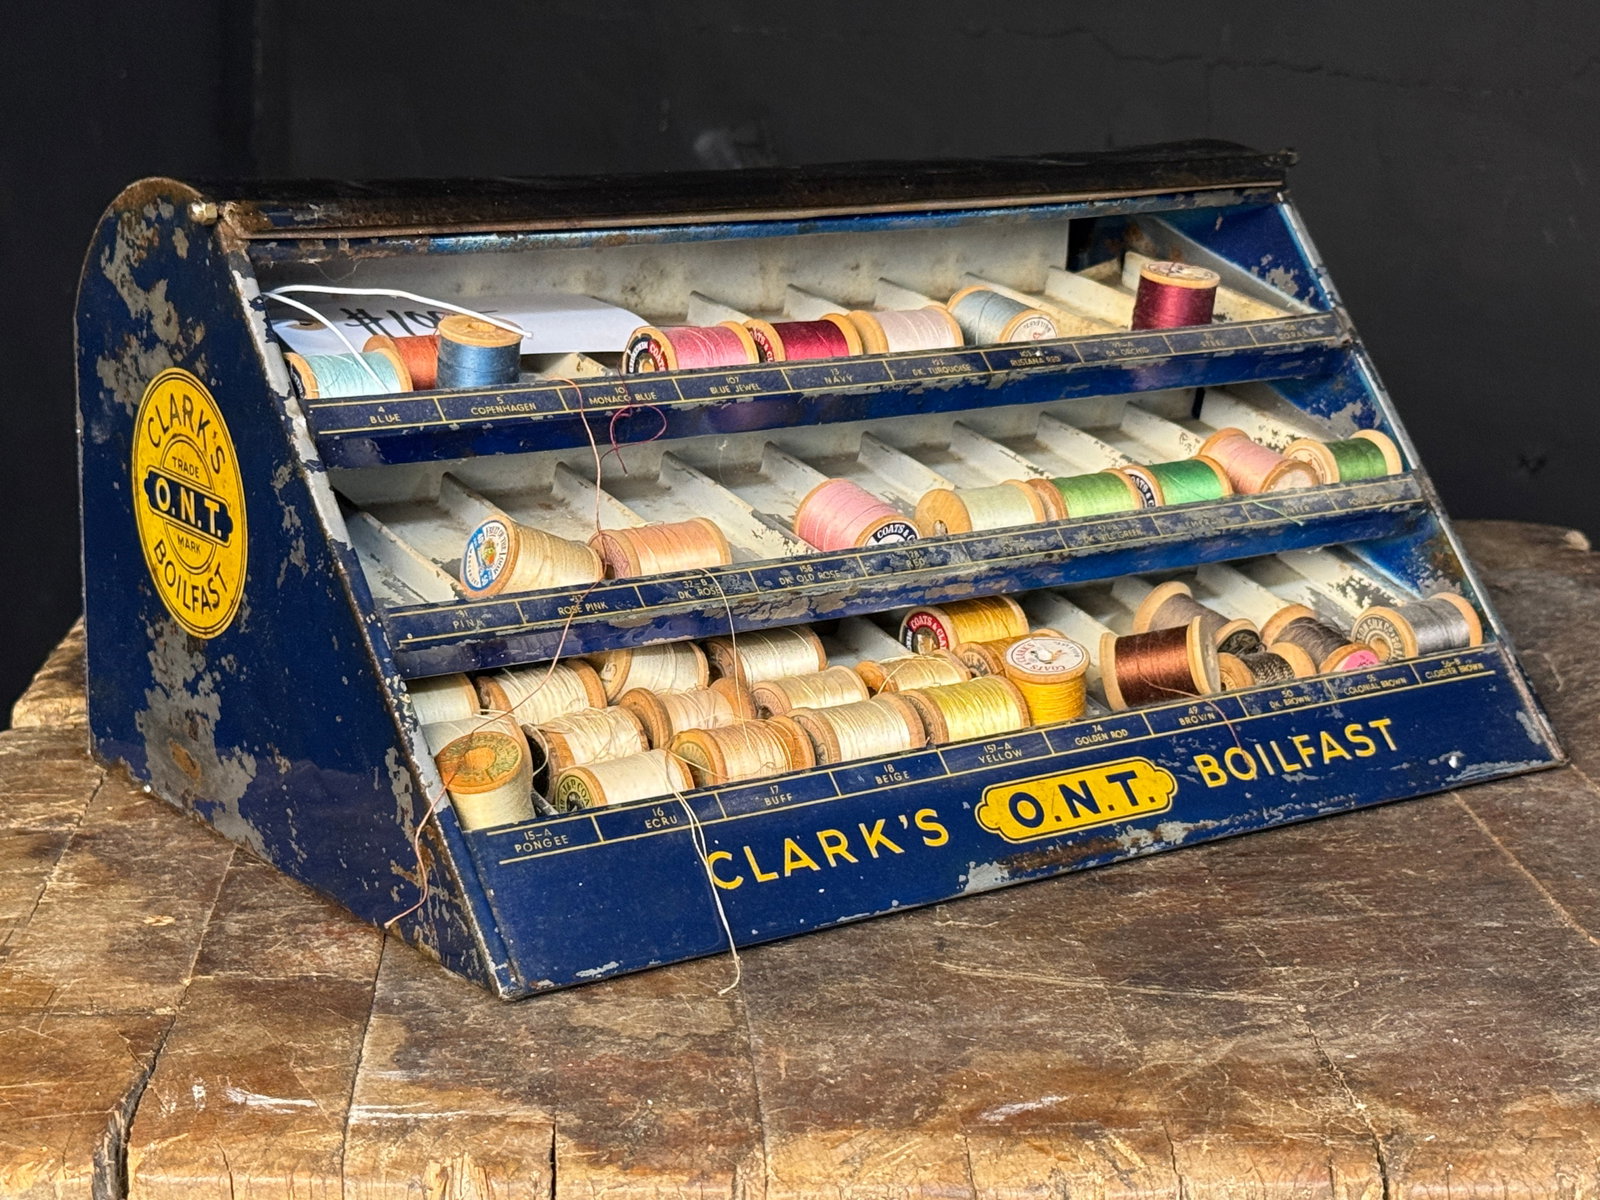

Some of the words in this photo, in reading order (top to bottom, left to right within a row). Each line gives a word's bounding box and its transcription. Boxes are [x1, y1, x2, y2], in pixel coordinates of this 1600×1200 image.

[725, 375, 740, 385] 107
[824, 374, 854, 385] NAVY
[614, 386, 626, 395] 10
[709, 385, 732, 395] BLUE
[735, 382, 763, 393] JEWEL
[589, 394, 631, 406] MONACO
[635, 391, 658, 402] BLUE
[378, 405, 386, 414] 4
[471, 402, 537, 416] COPENHAGEN
[370, 413, 401, 425] BLUE
[148, 392, 225, 475] CLARK'S
[171, 455, 201, 480] TRADE
[155, 477, 223, 539] O.N.T.
[876, 523, 905, 539] COATS
[177, 535, 202, 554] MARK
[153, 538, 229, 615] BOILFAST
[796, 573, 815, 583] OLD
[818, 569, 842, 580] ROSE
[697, 587, 721, 598] ROSE
[557, 604, 582, 616] ROSE
[585, 602, 609, 612] PINK
[453, 619, 484, 630] PINK
[911, 615, 933, 629] COATS
[1458, 661, 1485, 674] BROWN
[1343, 681, 1380, 696] COLONIAL
[1380, 676, 1408, 689] BROWN
[1282, 690, 1294, 699] 50
[1283, 694, 1312, 707] BROWN
[1188, 705, 1198, 715] 49
[1178, 711, 1216, 726] BROWN
[1075, 732, 1108, 746] GOLDEN
[1110, 728, 1129, 739] ROD
[978, 748, 1022, 764] YELLOW
[883, 764, 895, 773] 18
[874, 770, 910, 785] BEIGE
[770, 785, 779, 795] 17
[706, 808, 950, 890] CLARK'S
[1008, 769, 1156, 829] O.N.T.
[1192, 718, 1398, 789] BOILFAST
[764, 792, 793, 807] BUFF
[652, 807, 664, 817] 16
[645, 814, 678, 830] ECRU
[523, 828, 553, 841] 15-A
[514, 834, 569, 853] PONGEE
